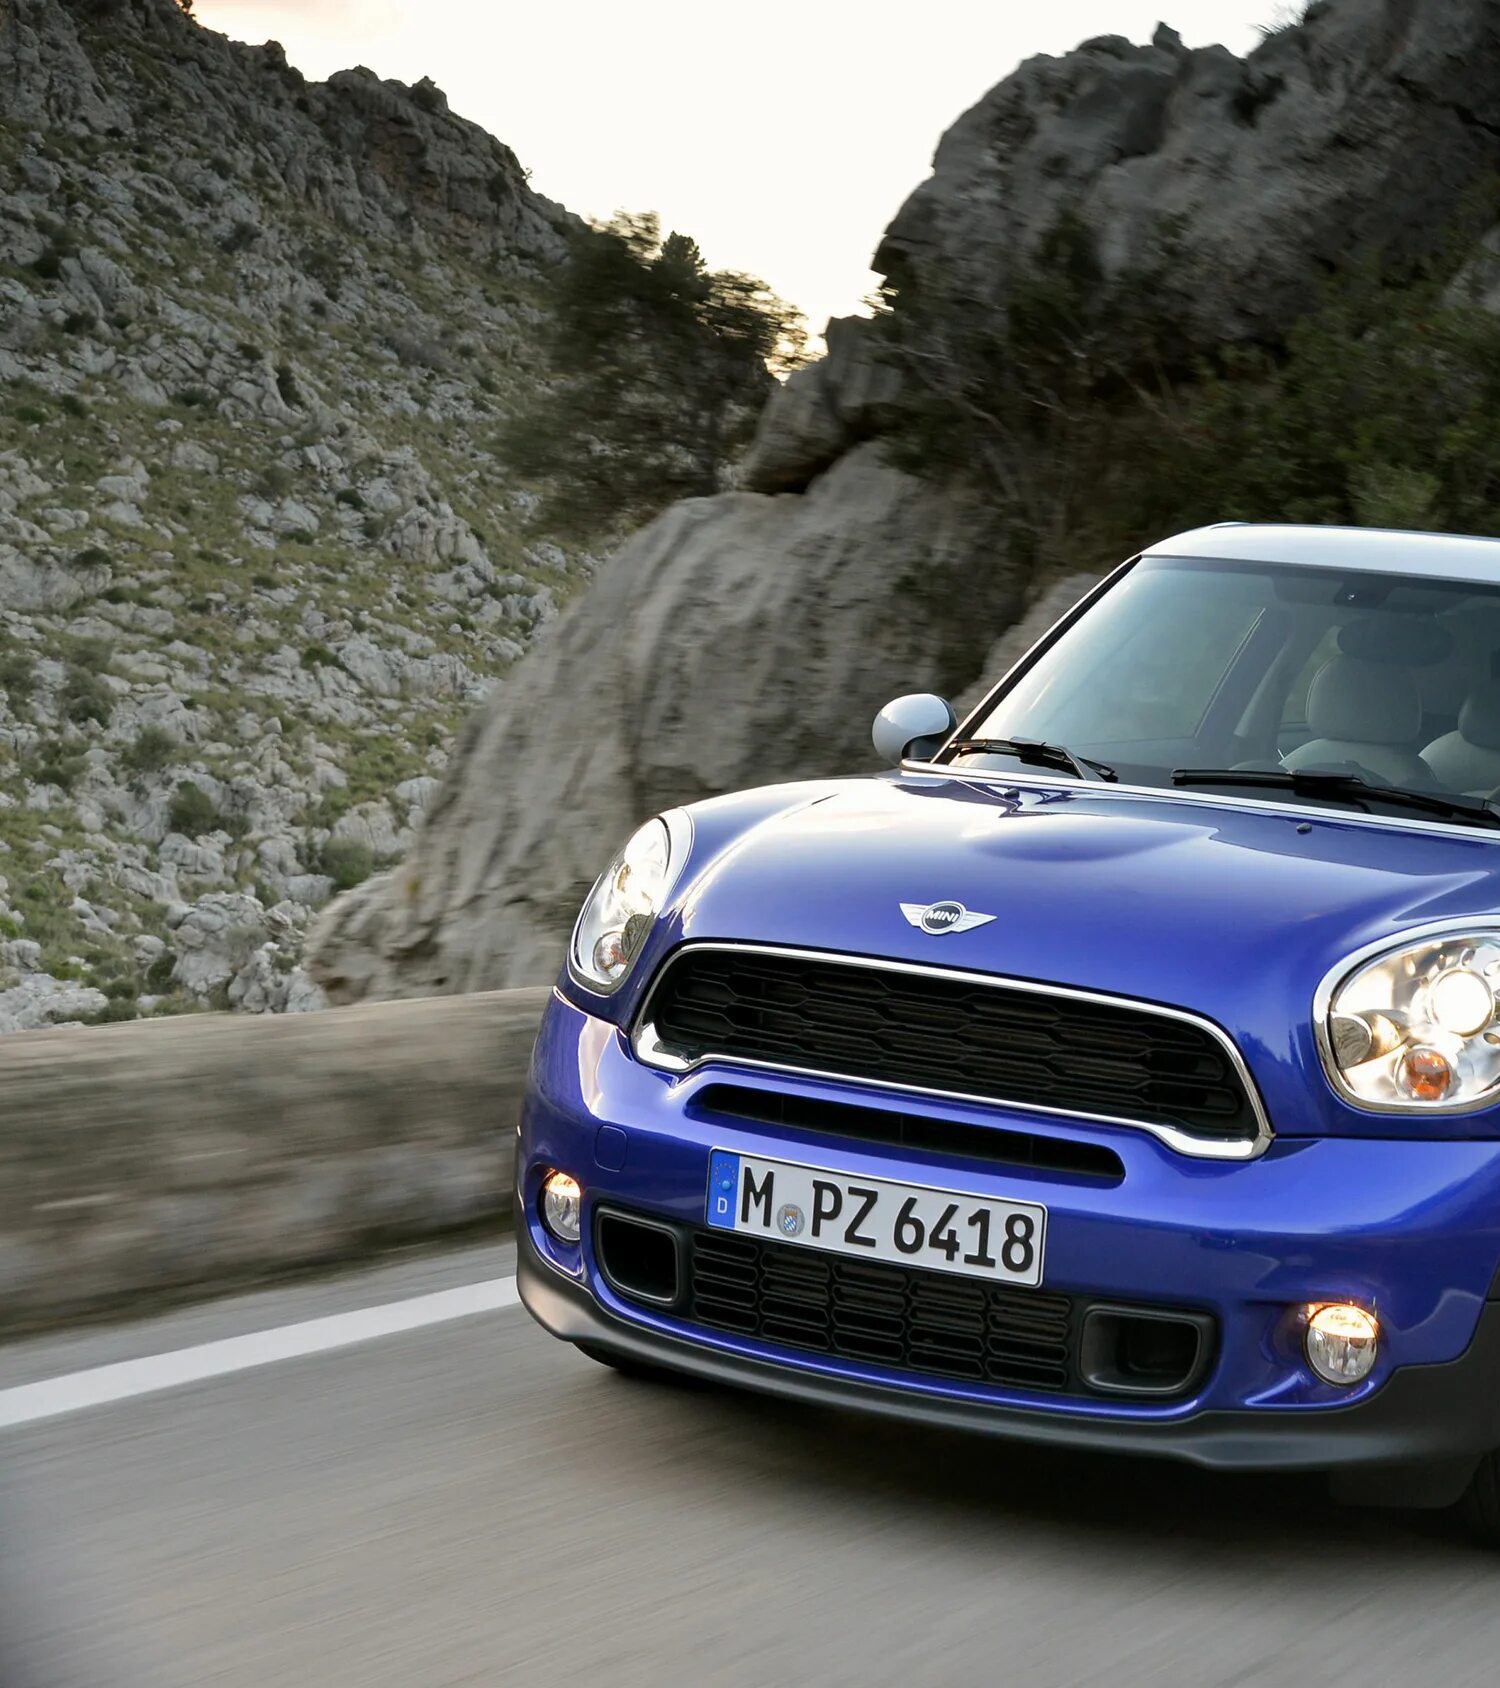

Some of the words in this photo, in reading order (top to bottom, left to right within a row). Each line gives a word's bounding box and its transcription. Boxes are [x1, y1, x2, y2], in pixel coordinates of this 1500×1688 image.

[925, 910, 960, 923] MINI
[717, 1196, 728, 1214] D
[741, 1166, 775, 1227] M
[811, 1179, 879, 1248] PZ
[893, 1196, 1035, 1273] 6418
